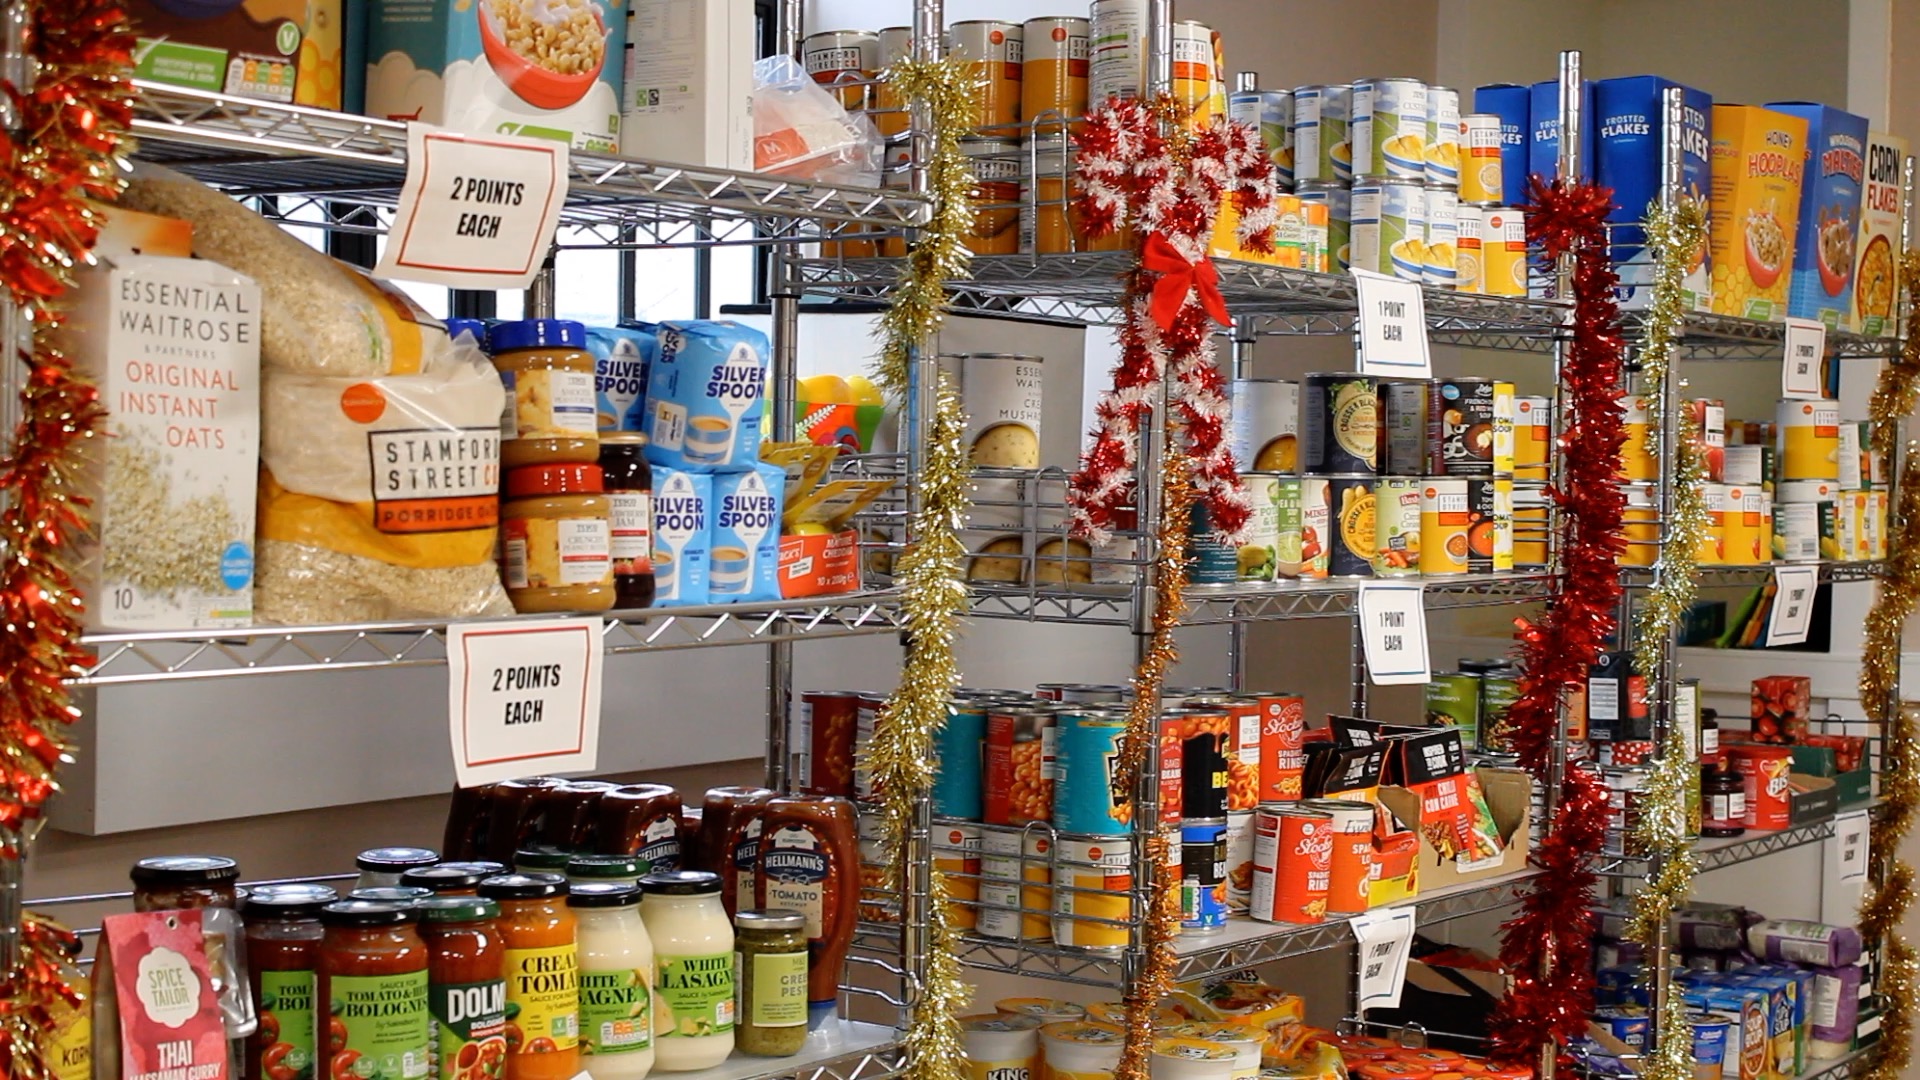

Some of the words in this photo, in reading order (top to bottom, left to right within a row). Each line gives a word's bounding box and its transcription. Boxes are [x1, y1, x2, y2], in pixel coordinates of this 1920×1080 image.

[1605, 114, 1645, 126] FROSTED
[1601, 123, 1650, 139] FLAKES
[1766, 131, 1792, 149] HONEY
[1747, 152, 1800, 188] HOOPLAS
[1869, 144, 1900, 187] CORN
[450, 177, 463, 200] 2
[465, 178, 525, 206] POINTS
[1867, 183, 1899, 214] FLAKES
[456, 213, 502, 238] EACH
[121, 279, 249, 313] ESSENTIAL
[120, 310, 249, 343] WAITROSE
[1383, 324, 1402, 341] EACH
[155, 346, 216, 360] PARTNERS
[126, 361, 239, 391] ORIGINAL
[597, 359, 647, 379] SILVER
[712, 365, 765, 382] SILVER
[595, 377, 646, 395] SPOON
[706, 382, 764, 398] SPOON
[120, 392, 218, 419] INSTANT
[166, 426, 225, 450] OATS
[388, 466, 477, 490] STREET
[723, 495, 776, 512] SILVER
[384, 506, 473, 523] PORRIDGE
[616, 518, 635, 527] JAM
[656, 515, 704, 530] POON
[719, 512, 776, 528] SPOON
[114, 589, 133, 610] 10
[1384, 612, 1405, 627] POINT
[1384, 635, 1402, 651] EACH
[492, 668, 502, 691] 2
[506, 664, 561, 690] POINTS
[504, 700, 543, 725] EACH
[765, 854, 825, 872] HELLMANN'S
[771, 889, 818, 901] TOMATO
[683, 956, 728, 972] WHITE
[148, 968, 185, 989] SPICE
[380, 981, 404, 989] SAUCE
[517, 970, 577, 994] TOMA
[580, 975, 619, 988] HITE
[151, 986, 190, 1007] TAILOR
[347, 990, 401, 1002] TOMATO
[448, 981, 506, 1023] DOLM
[530, 995, 551, 1003] SAUCE
[591, 1008, 624, 1016] Sainsbury's
[157, 1040, 193, 1069] THAI
[187, 1062, 221, 1080] CURRY
